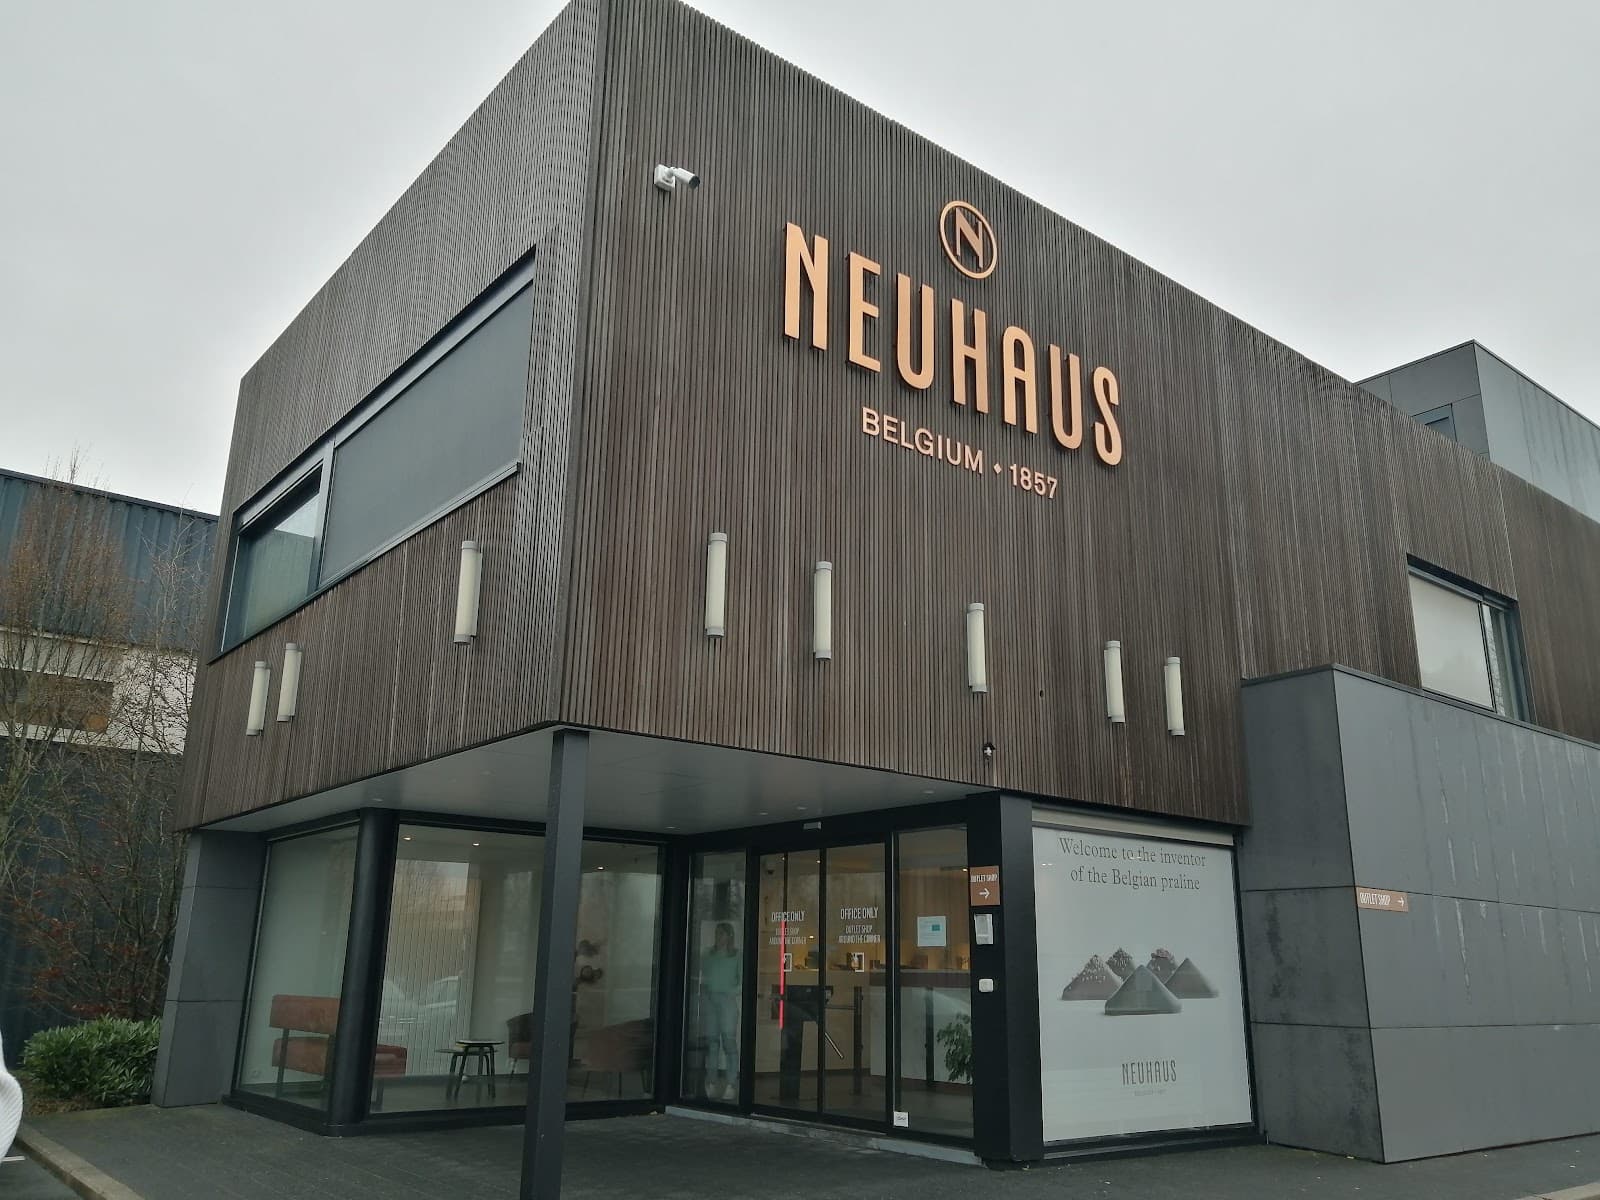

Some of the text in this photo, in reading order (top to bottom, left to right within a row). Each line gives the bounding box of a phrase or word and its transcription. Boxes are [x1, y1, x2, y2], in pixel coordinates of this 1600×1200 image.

[784, 221, 1122, 466] NEUHAUS
[861, 406, 1058, 499] BELGIUM 1857
[1058, 837, 1206, 867] Welcome to the inventor
[1070, 865, 1201, 892] of the Belgian praline
[771, 910, 805, 922] OFFICE ONLY
[840, 906, 879, 920] OFFICE ONLY
[1121, 1059, 1177, 1086] NEUHAUS
